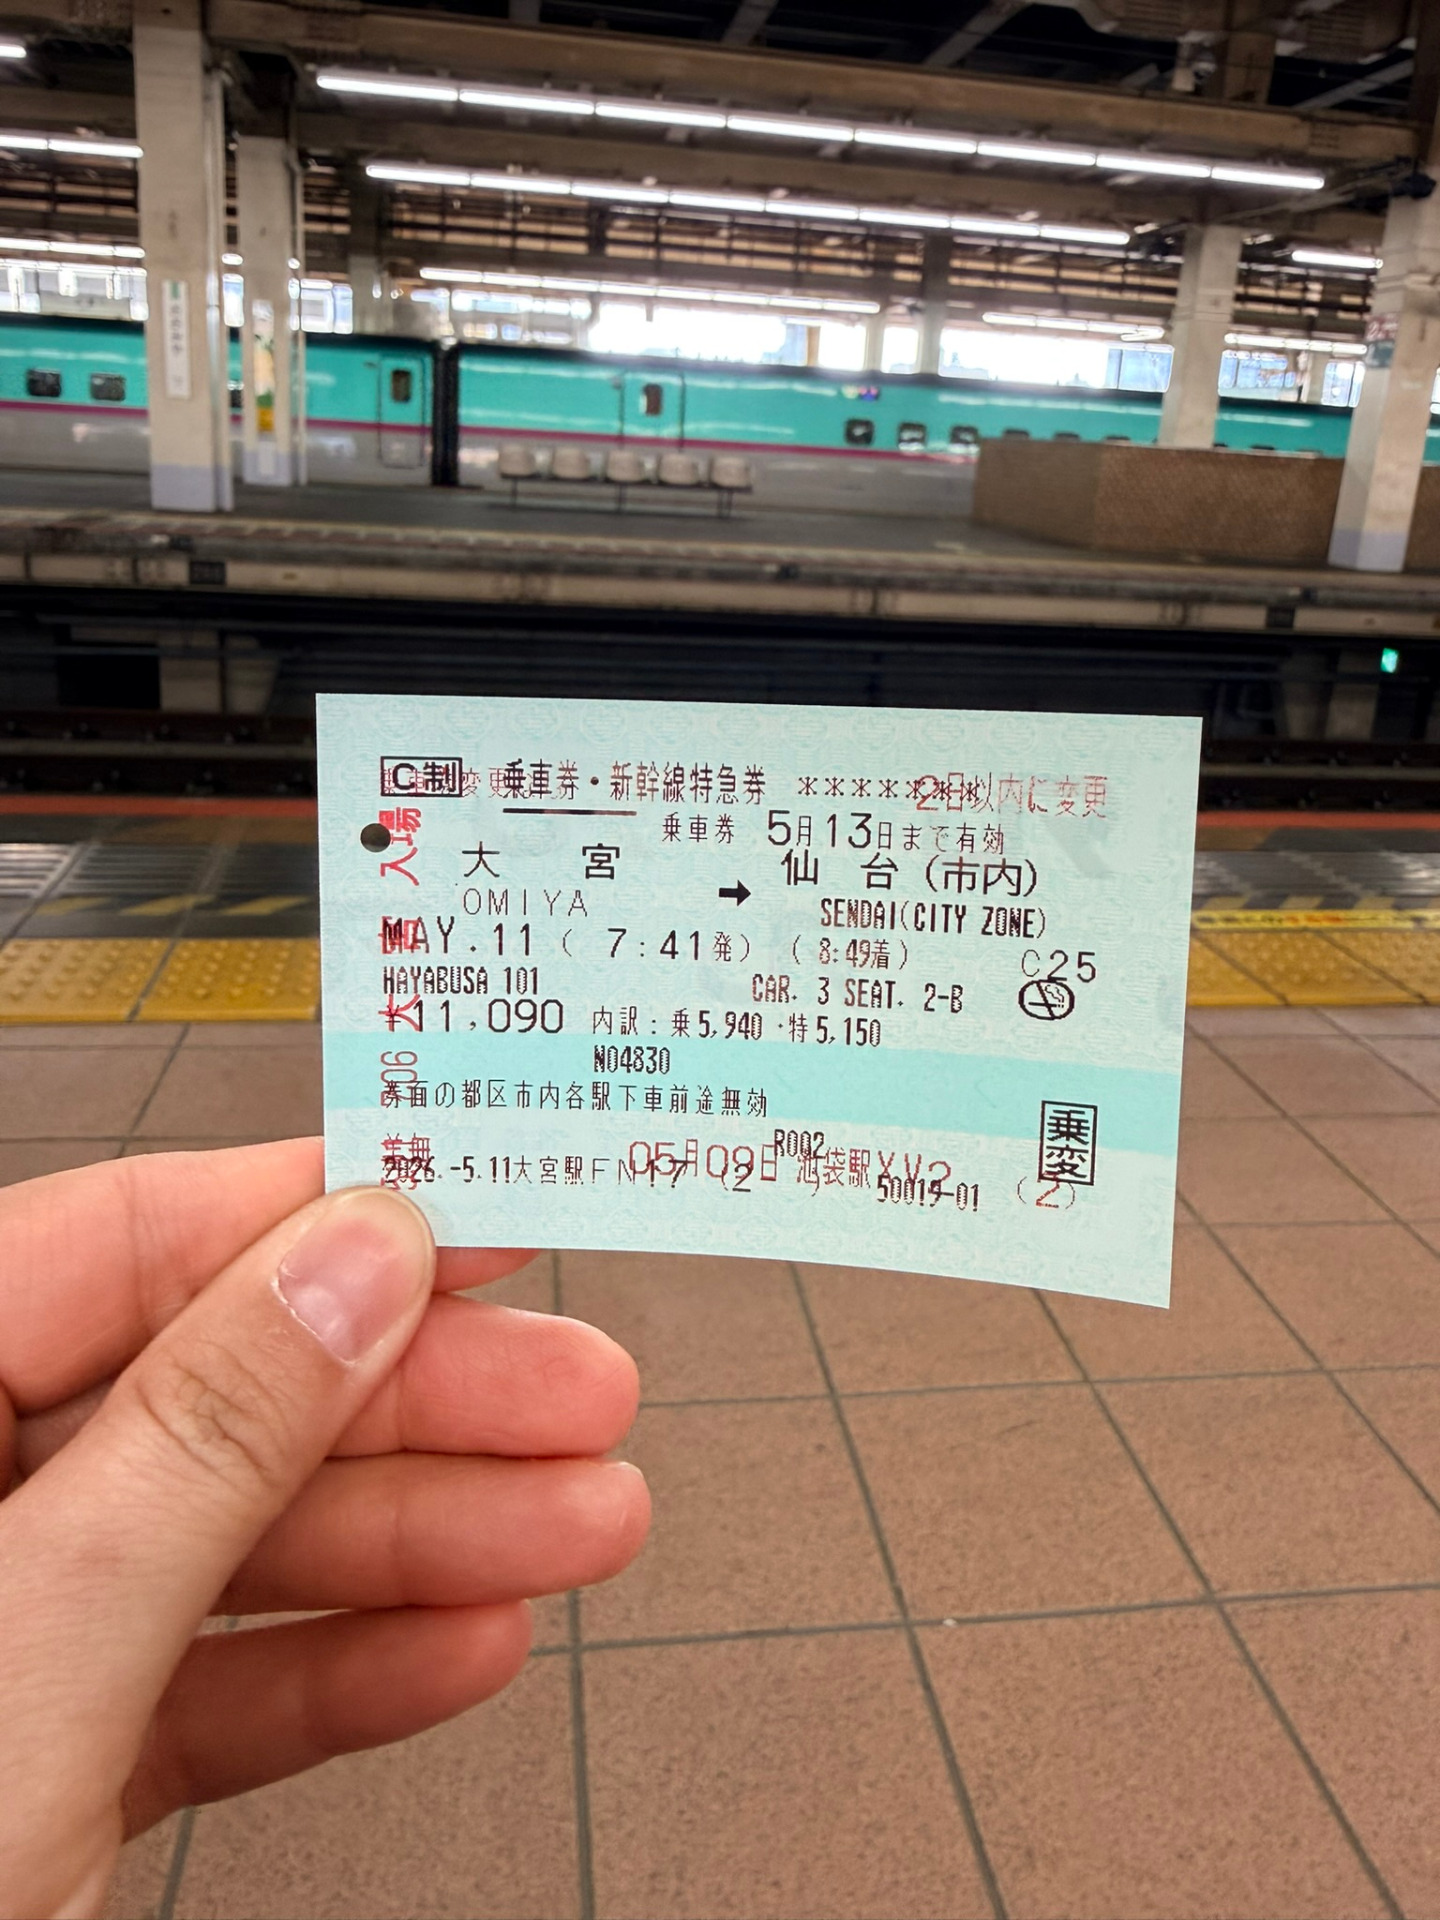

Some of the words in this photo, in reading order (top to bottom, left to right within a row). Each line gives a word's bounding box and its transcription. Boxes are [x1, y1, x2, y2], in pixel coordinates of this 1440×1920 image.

[503, 758, 766, 805] 乗車券・新幹線特急券
[662, 813, 735, 844] 乗車券
[768, 809, 1005, 855] 5月13日まで有効
[463, 887, 588, 917] OMIYA
[821, 898, 967, 935] SENDAI(CITY
[981, 906, 1047, 939] ZONE)
[383, 965, 489, 995] HAYABUSA
[503, 966, 539, 995] 101
[1021, 948, 1097, 984] C25
[752, 973, 799, 1004] CAR.
[817, 976, 830, 1007] 3
[844, 978, 905, 1010] SEAT.
[923, 984, 964, 1015] 2-B
[775, 1129, 826, 1160] R002
[1046, 1107, 1092, 1181] 乗変
